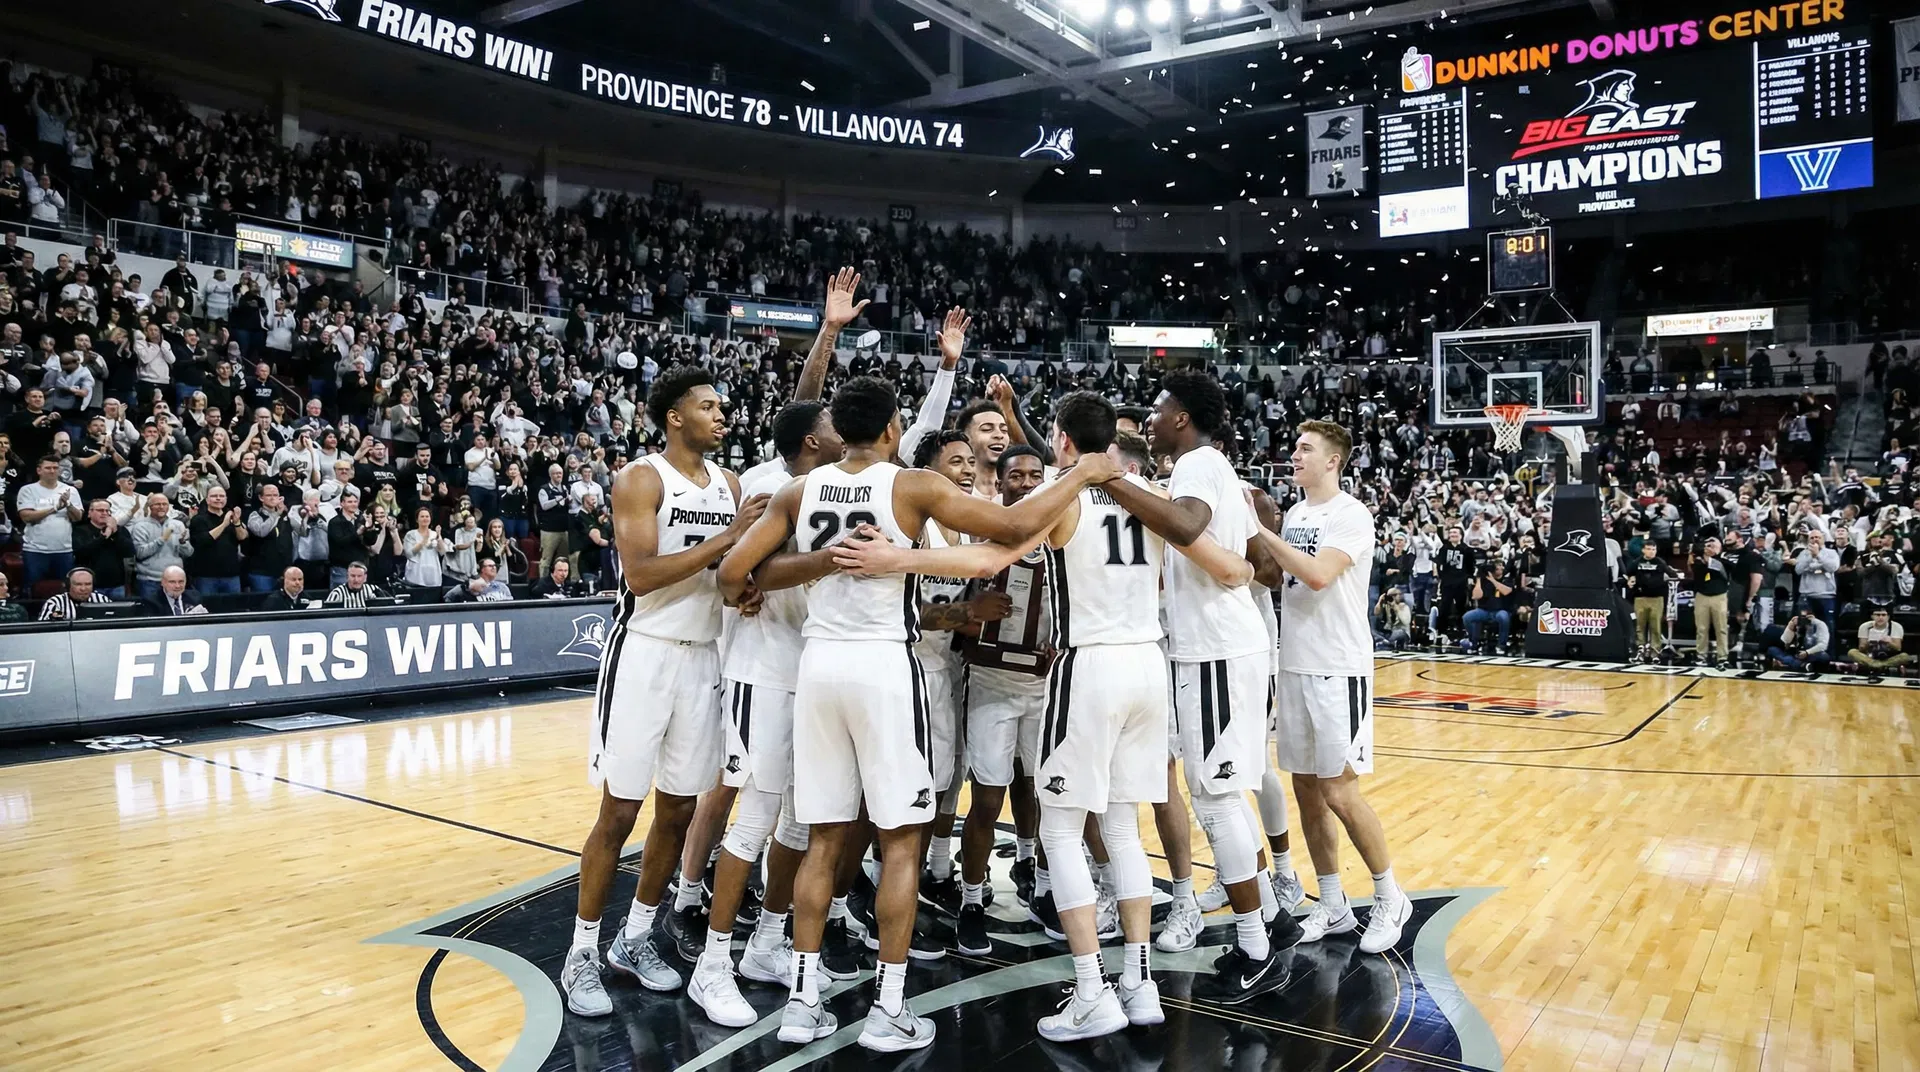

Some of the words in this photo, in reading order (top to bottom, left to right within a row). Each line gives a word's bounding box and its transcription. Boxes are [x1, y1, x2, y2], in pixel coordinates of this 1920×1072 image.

[358, 0, 477, 58] FRIARS
[484, 32, 554, 82] WIN!
[1436, 43, 1559, 84] DUNKIN'
[1567, 20, 1698, 64] DONUTS
[1708, 0, 1845, 41] CENTER
[581, 64, 734, 119] PROVIDENCE
[740, 97, 771, 126] 78
[795, 105, 927, 145] VILLANOVA
[933, 122, 964, 148] 74
[1520, 115, 1589, 145] BIG
[1586, 101, 1698, 136] EAST
[1311, 145, 1361, 164] FRIARS
[1496, 140, 1722, 196] CHAMPIONS
[1102, 514, 1150, 566] 11
[114, 629, 367, 700] FRIARS
[385, 620, 513, 676] WIN!
